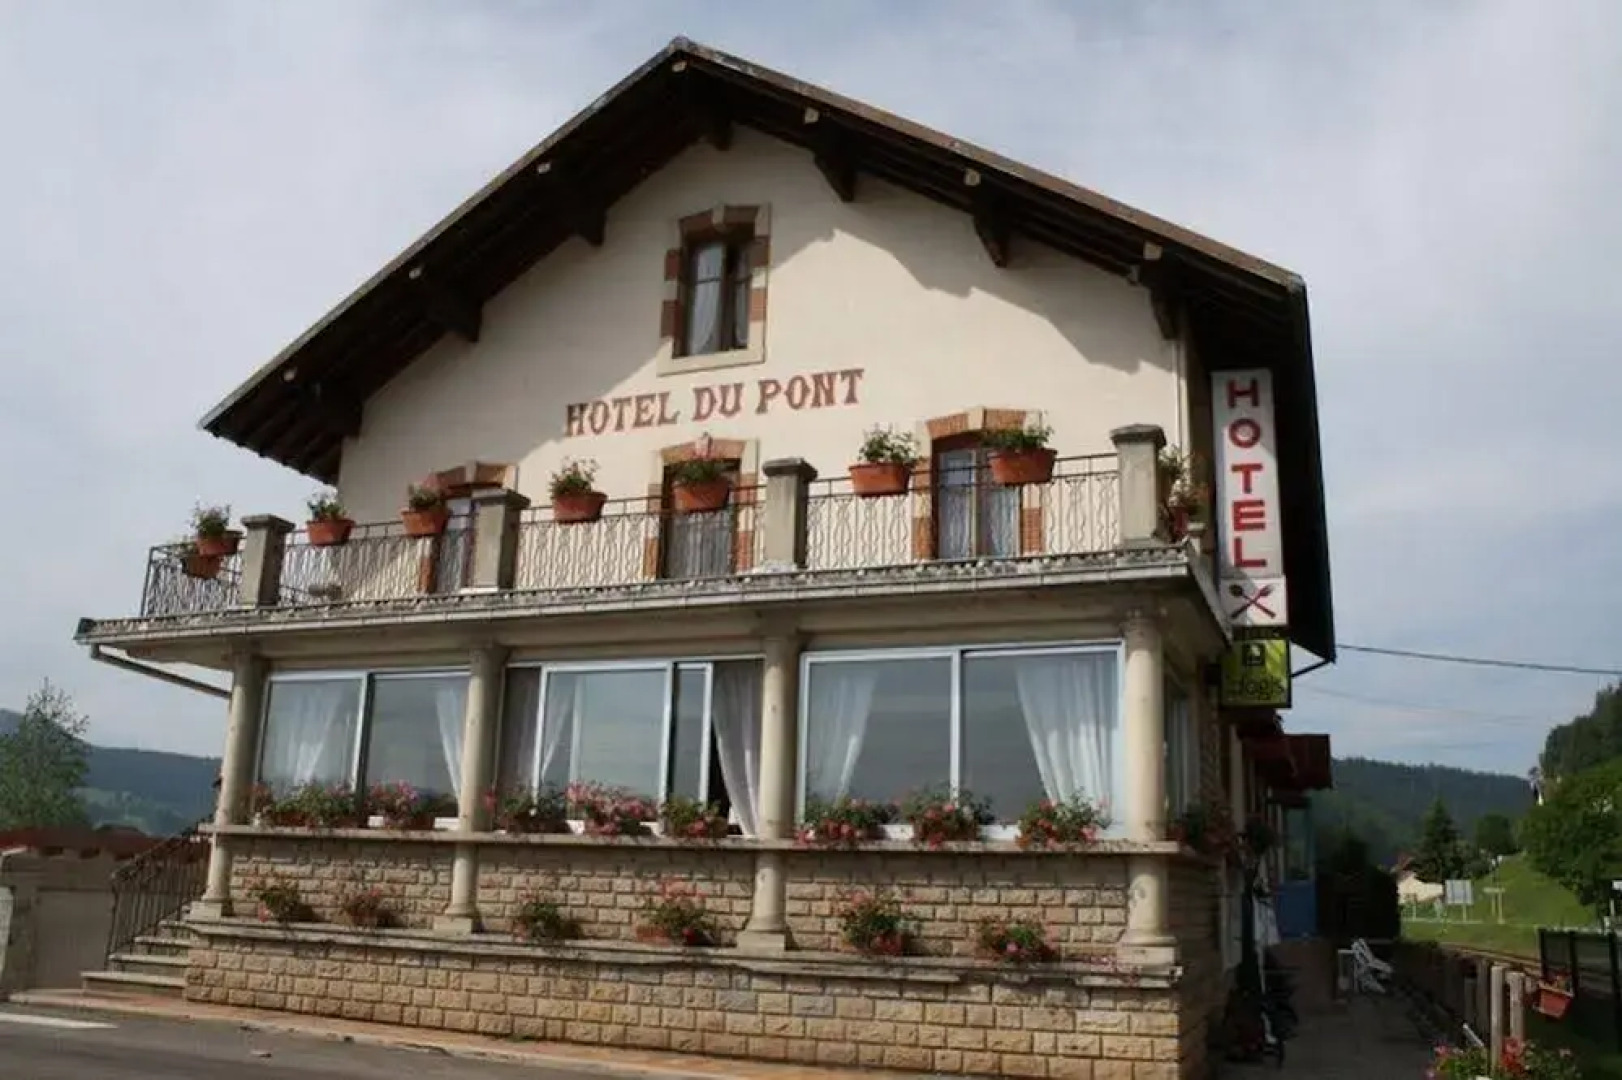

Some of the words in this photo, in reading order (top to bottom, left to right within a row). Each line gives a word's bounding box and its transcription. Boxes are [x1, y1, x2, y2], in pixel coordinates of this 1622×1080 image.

[565, 392, 681, 437] HOTEL
[692, 383, 744, 422] DU
[755, 369, 864, 414] PONT
[1227, 377, 1267, 568] HOTEL
